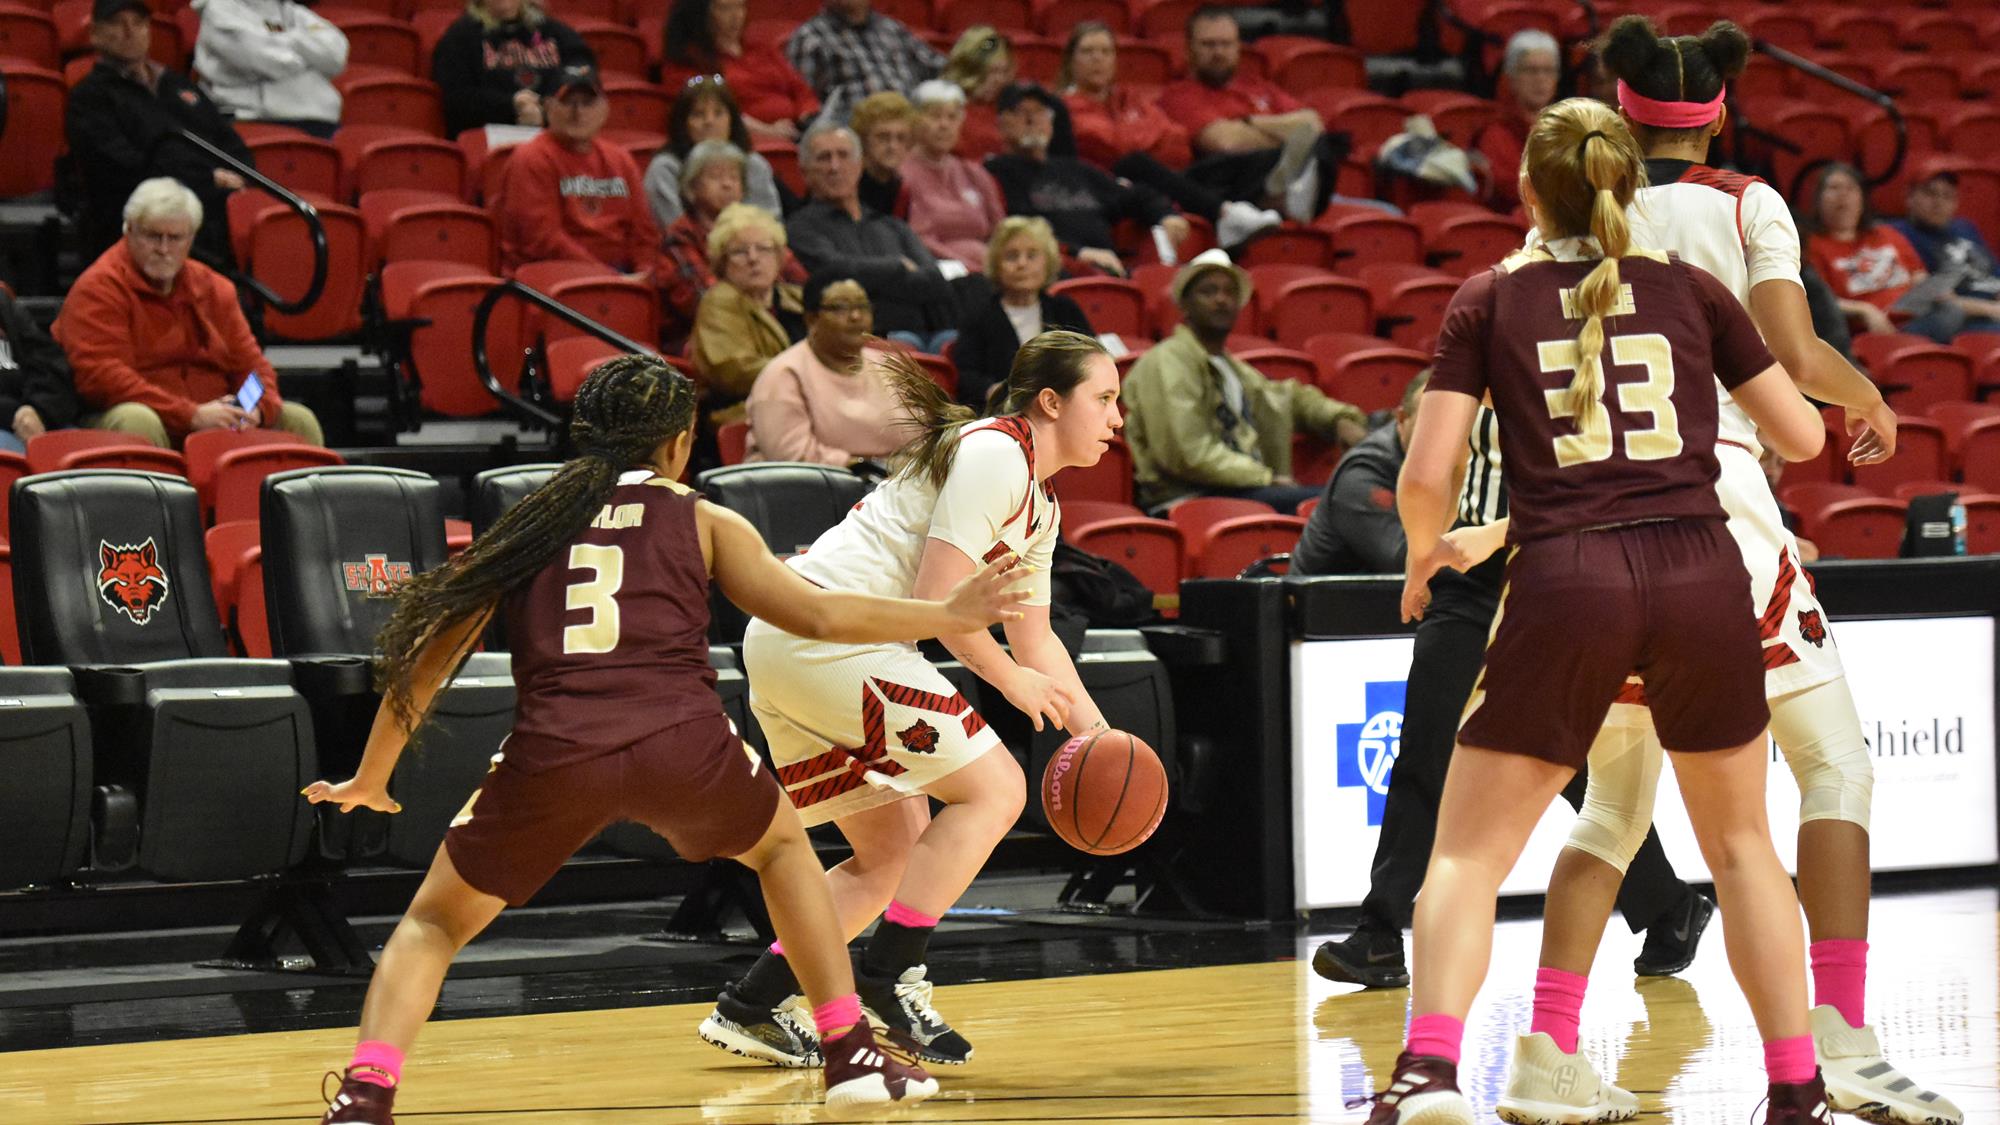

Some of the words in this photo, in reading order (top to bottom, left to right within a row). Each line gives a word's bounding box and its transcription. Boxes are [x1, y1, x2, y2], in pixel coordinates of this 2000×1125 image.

[1537, 333, 1684, 468] 33
[563, 543, 624, 654] 3
[1051, 736, 1090, 811] Wilson
[1864, 717, 1965, 758] hield
